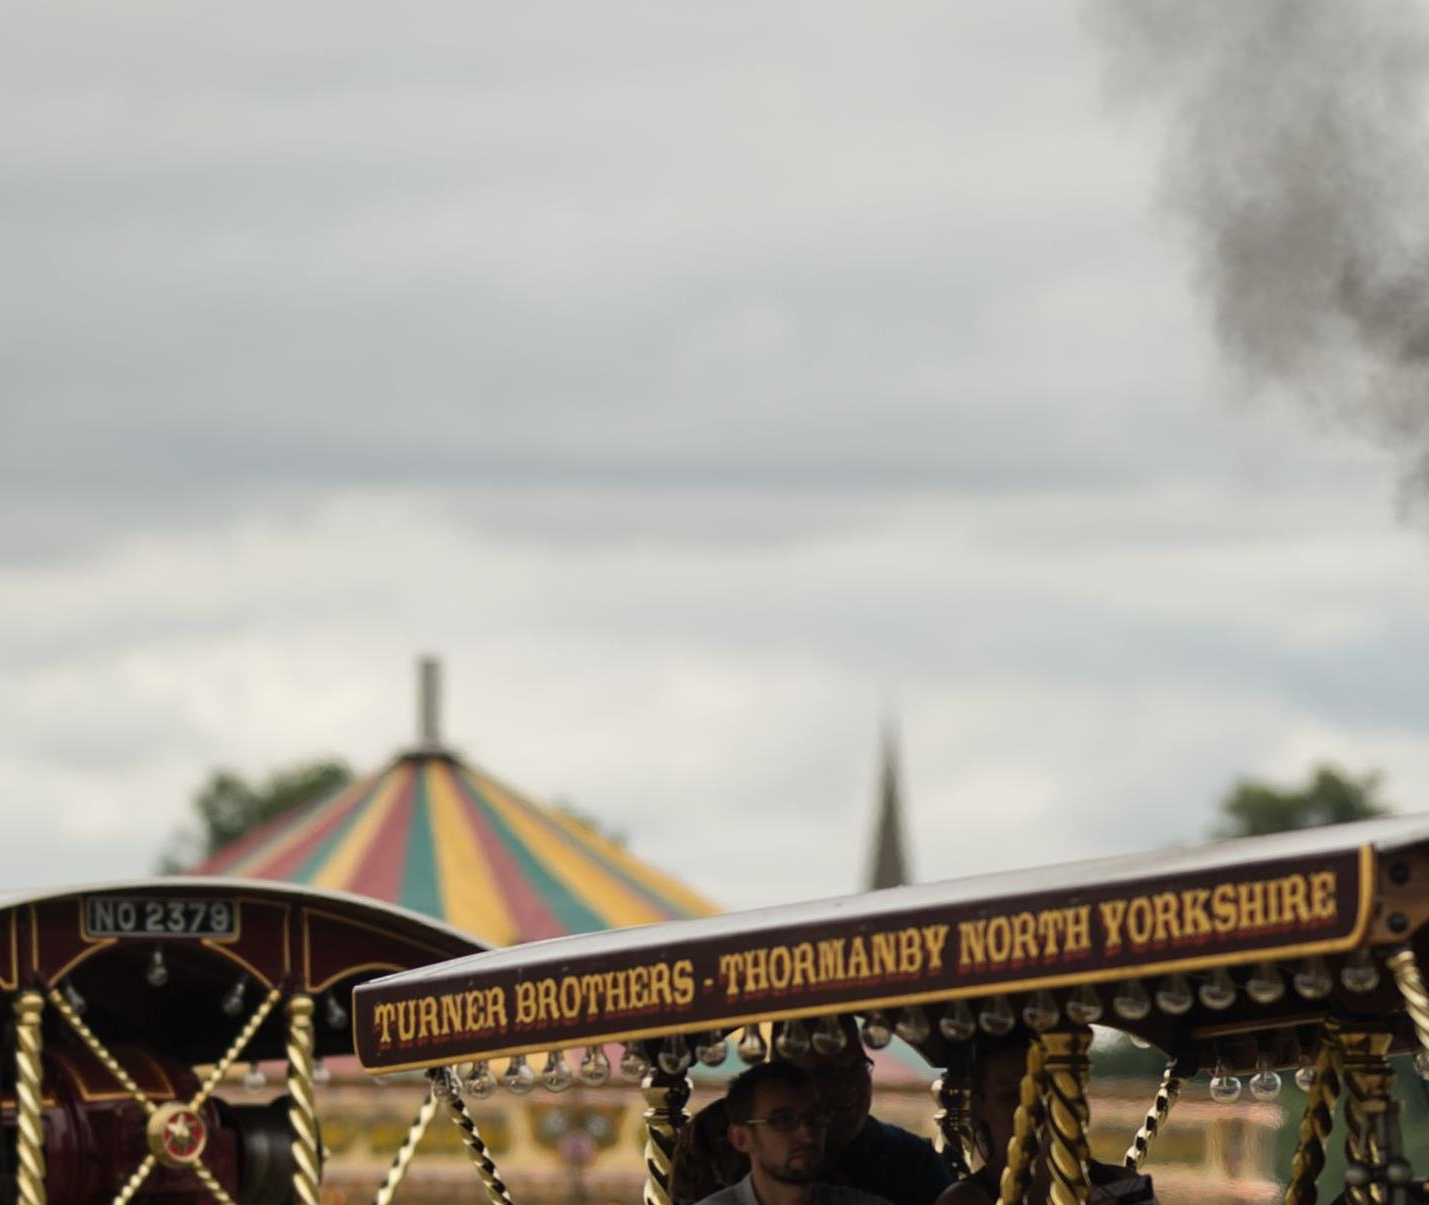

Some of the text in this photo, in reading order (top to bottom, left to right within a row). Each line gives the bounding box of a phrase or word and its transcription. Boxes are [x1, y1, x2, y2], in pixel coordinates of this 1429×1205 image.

[145, 900, 230, 932] 2379
[374, 986, 508, 1045] TURNER
[515, 959, 696, 1024] BROTHERS
[719, 924, 950, 995] THORMANBY
[958, 904, 1093, 966] NORTH
[1098, 870, 1338, 944] YORKSHIRE
